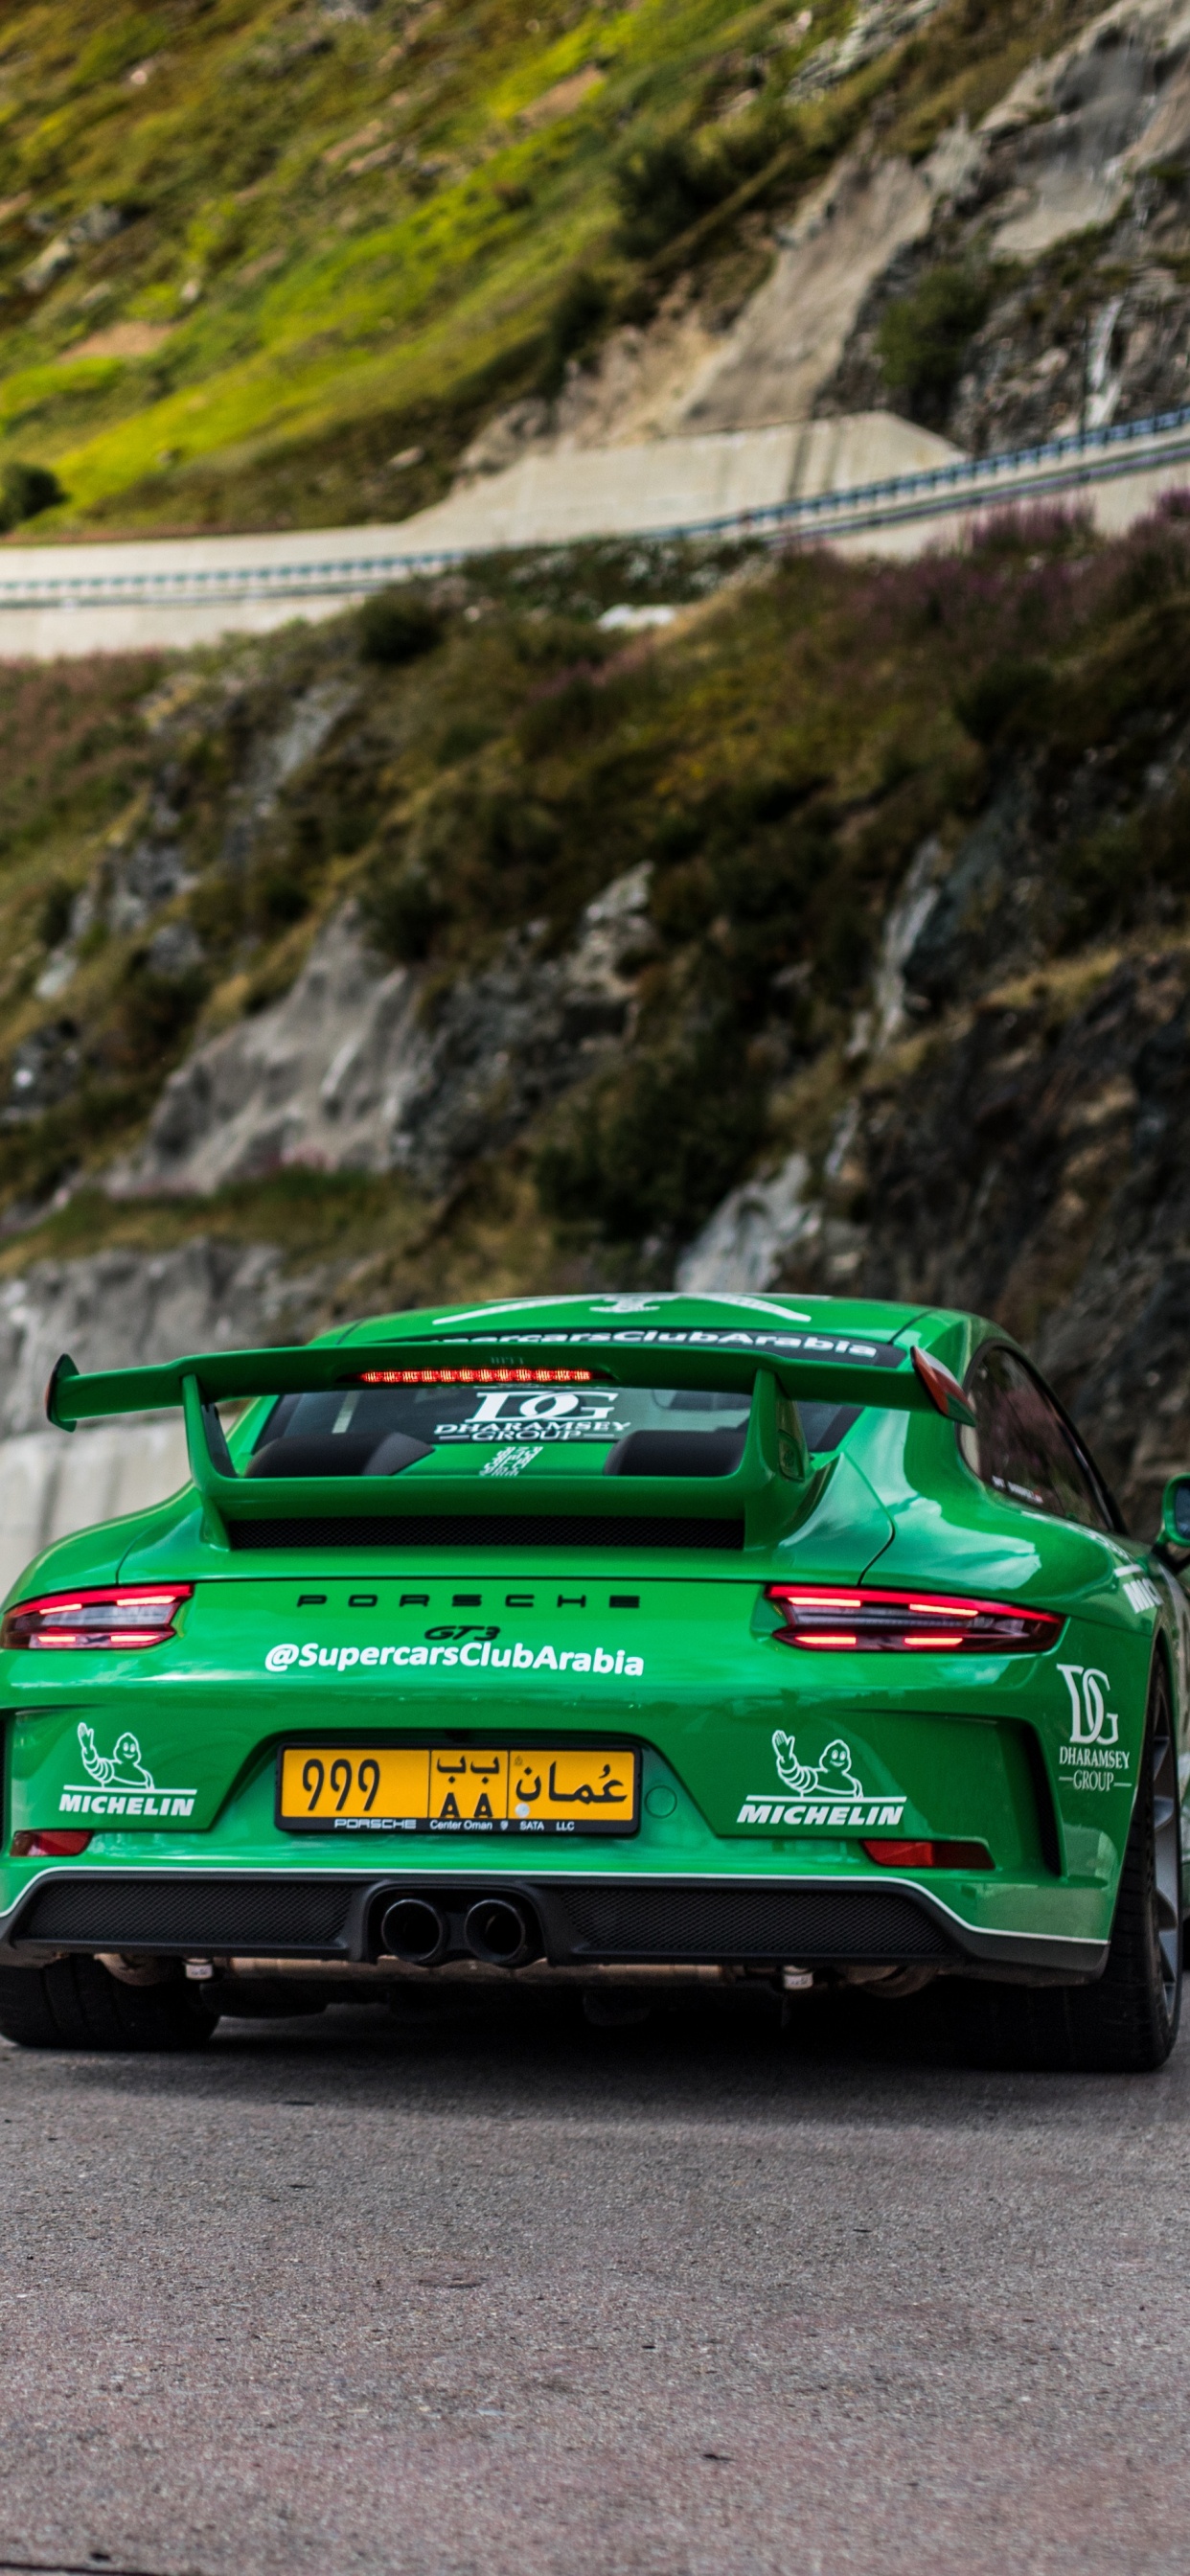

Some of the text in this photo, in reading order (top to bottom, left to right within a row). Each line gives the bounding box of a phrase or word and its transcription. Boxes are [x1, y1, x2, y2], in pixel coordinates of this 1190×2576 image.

[465, 1391, 619, 1423] DG
[434, 1421, 631, 1435] DHARAMSEY
[471, 1430, 582, 1441] GROUP
[297, 1594, 641, 1609] PORSCHE
[424, 1625, 501, 1641] GT3
[264, 1642, 644, 1676] @SupercarsClubArabia
[1056, 1663, 1119, 1745] DG
[1059, 1745, 1131, 1769] DHARAMSEY
[302, 1759, 381, 1811] 999
[1072, 1770, 1114, 1792] GROUP
[58, 1794, 195, 1816] MICHELIN
[736, 1805, 904, 1826] MICHELIN
[334, 1819, 575, 1831] PORSCHE Center Oman SATA LLC
